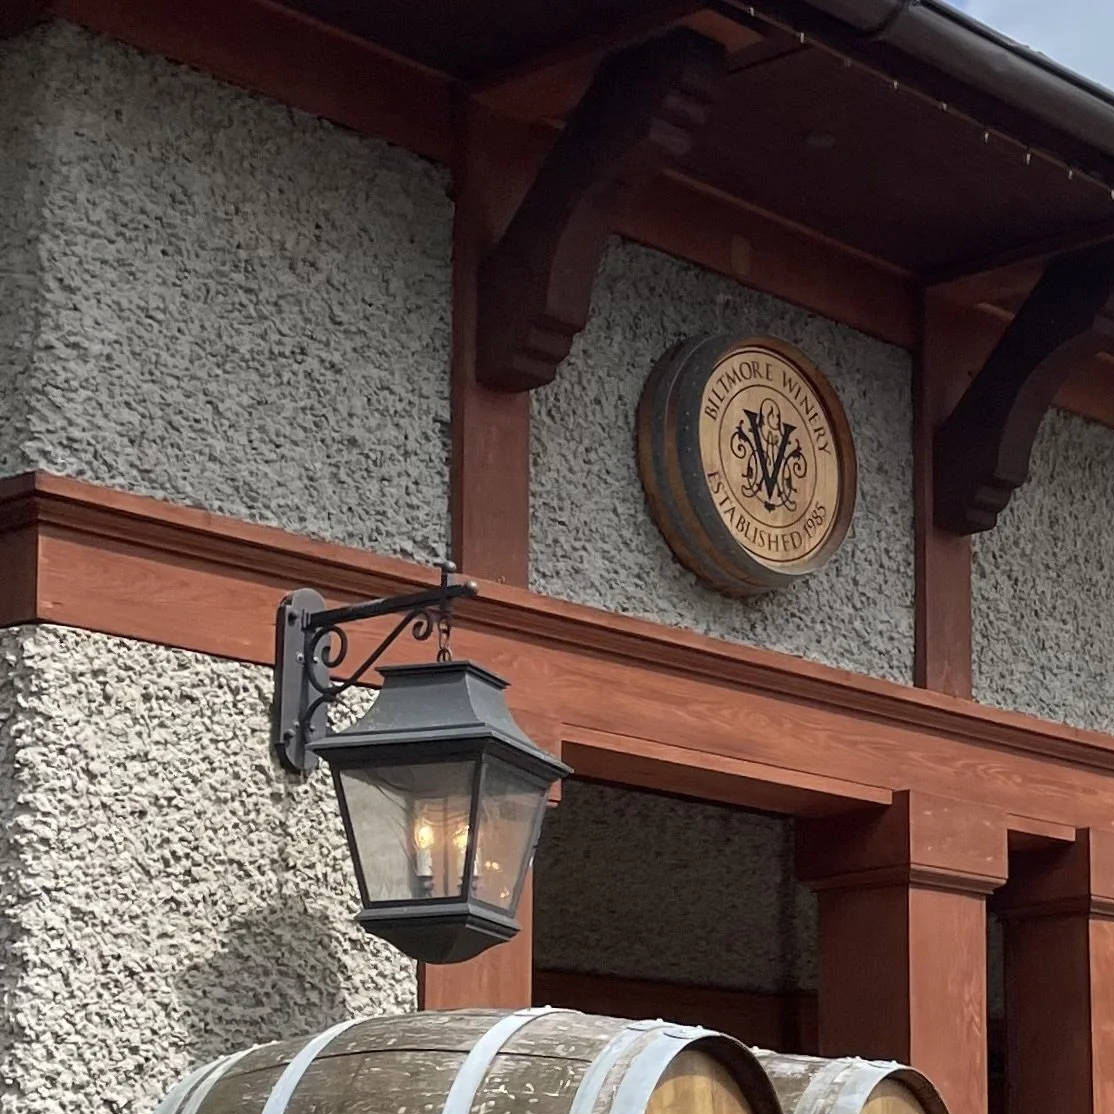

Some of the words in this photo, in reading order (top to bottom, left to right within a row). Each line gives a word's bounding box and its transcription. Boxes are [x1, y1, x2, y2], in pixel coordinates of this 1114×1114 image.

[704, 361, 774, 421] BILTMORE
[782, 370, 832, 457] WINERY
[707, 470, 803, 552] ESTABLISHED
[803, 503, 828, 538] 1985
